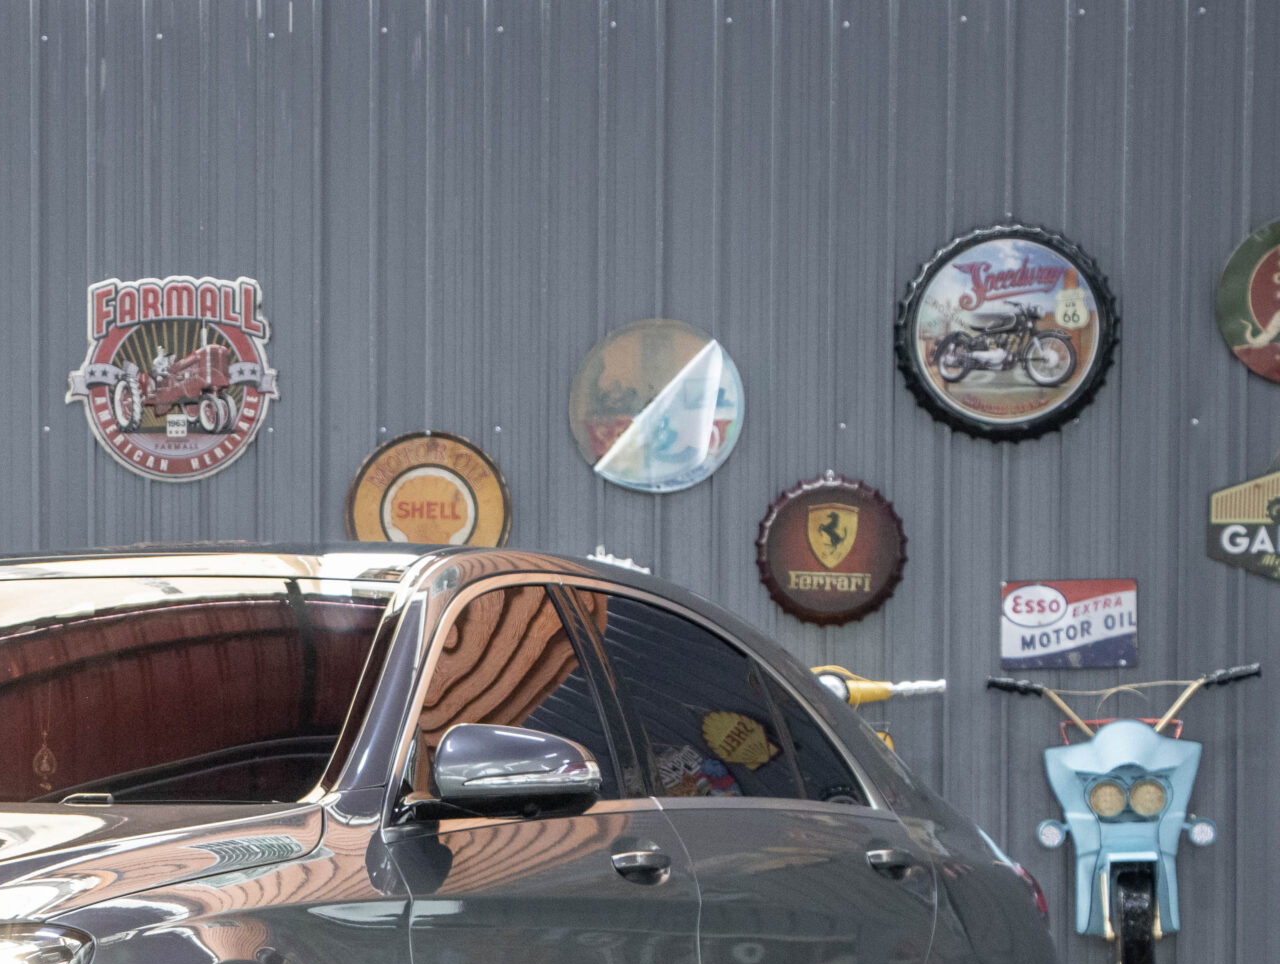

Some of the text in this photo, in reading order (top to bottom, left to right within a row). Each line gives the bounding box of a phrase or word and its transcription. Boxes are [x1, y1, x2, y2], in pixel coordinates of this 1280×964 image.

[952, 257, 1065, 311] Speedway
[93, 282, 264, 337] FARMALL
[1062, 312, 1081, 324] 66
[94, 394, 260, 472] AMERICAN HERITAGE
[166, 417, 187, 428] 1963
[367, 442, 449, 490] MOTOR
[397, 502, 462, 520] SHELL
[1221, 524, 1280, 555] GA
[788, 570, 872, 592] Ferrari
[1072, 596, 1123, 619] EXTRA
[1020, 611, 1137, 651] MOTOR OIL
